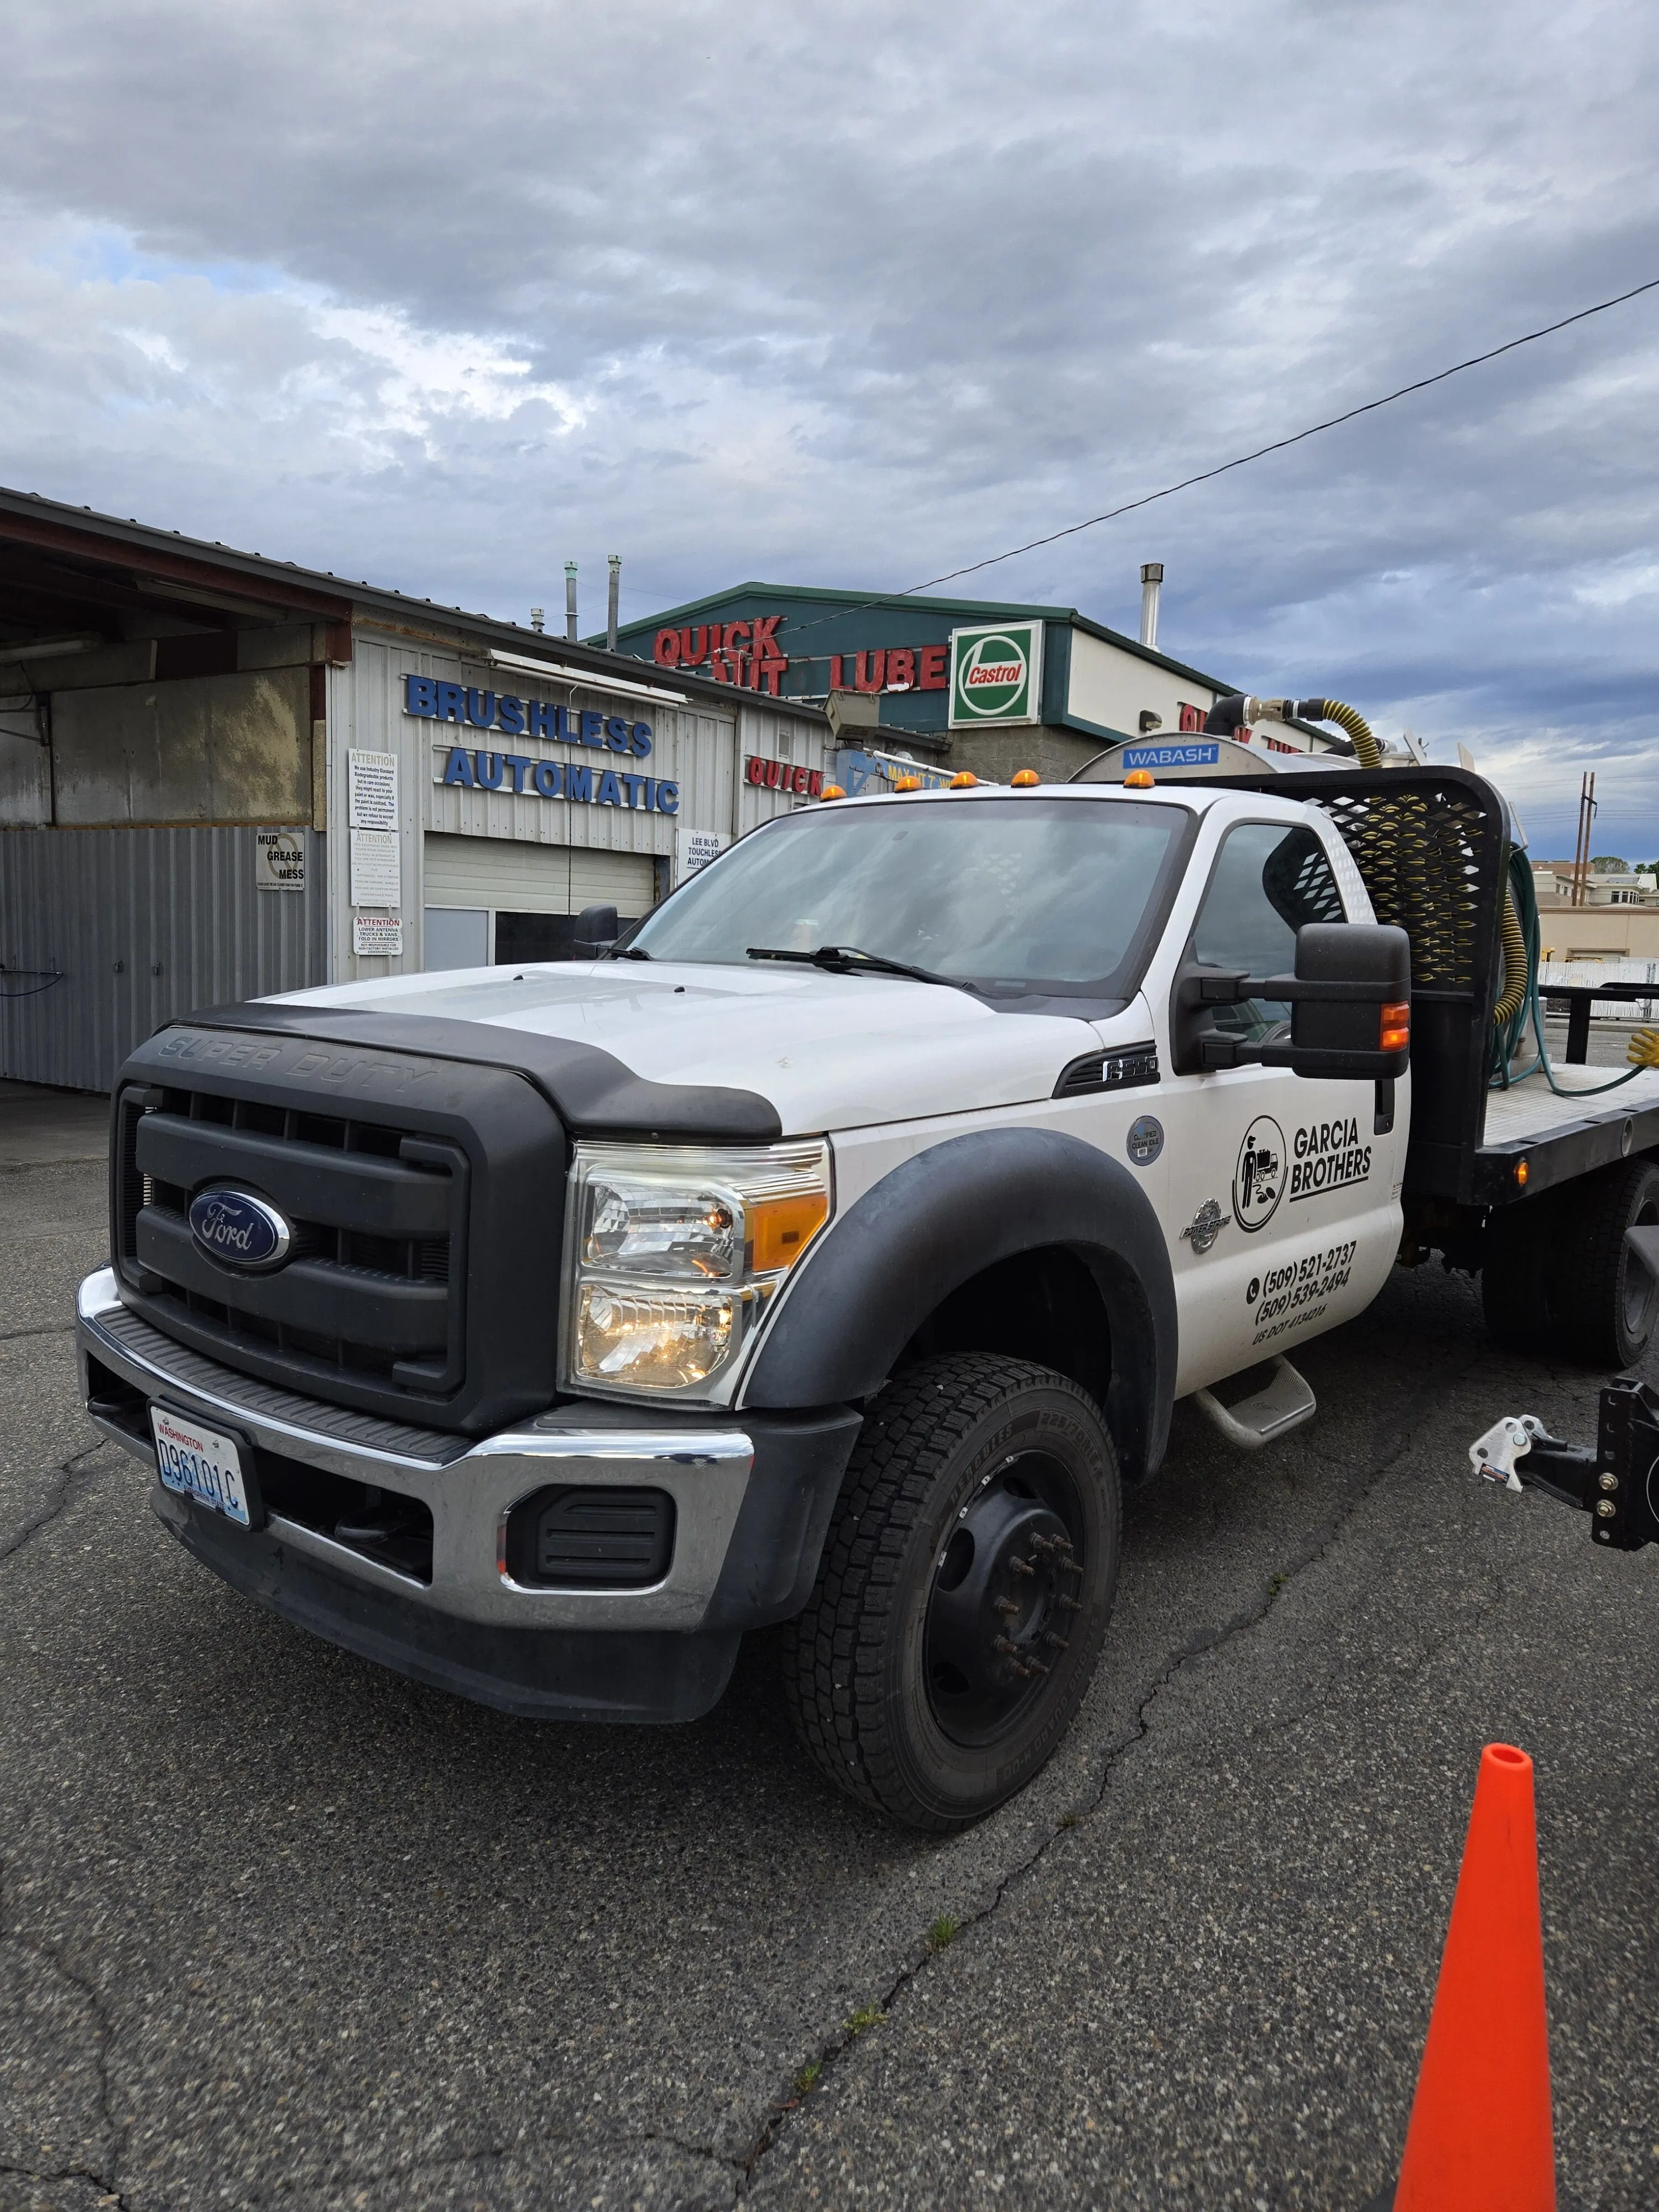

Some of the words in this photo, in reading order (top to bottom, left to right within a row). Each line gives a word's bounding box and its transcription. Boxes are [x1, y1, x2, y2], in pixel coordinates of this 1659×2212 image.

[654, 615, 784, 667] QUICK
[830, 645, 948, 692] LUBE
[969, 663, 1022, 685] Castrol
[407, 674, 653, 758] BRUSHLESS
[351, 752, 395, 766] ATTENTION
[1129, 748, 1212, 765] WABASH
[444, 747, 680, 815] AUTOMATIC
[749, 756, 825, 797] QUICK
[258, 835, 278, 845] MUD
[357, 833, 392, 844] ATTENTION
[692, 837, 703, 846] LEE
[704, 838, 719, 847] BLVD
[267, 851, 303, 862] GREASE
[279, 869, 304, 880] MESS
[159, 1036, 283, 1071] SUPER
[285, 1051, 441, 1093] DUTY
[1132, 1140, 1147, 1149] CLEAN
[1149, 1138, 1160, 1146] IDLE
[1294, 1117, 1358, 1159] GARCIA
[1290, 1146, 1371, 1194] BROTHERS
[202, 1202, 254, 1250] Ford
[1184, 1223, 1209, 1236] POWER
[1208, 1215, 1232, 1232] STROKE
[1253, 1329, 1268, 1345] US
[1266, 1319, 1290, 1339] DOT
[1288, 1303, 1327, 1329] 4134216
[157, 1422, 204, 1452] WASHINGTON
[158, 1438, 239, 1509] D96101C
[211, 1498, 225, 1511] STATE
